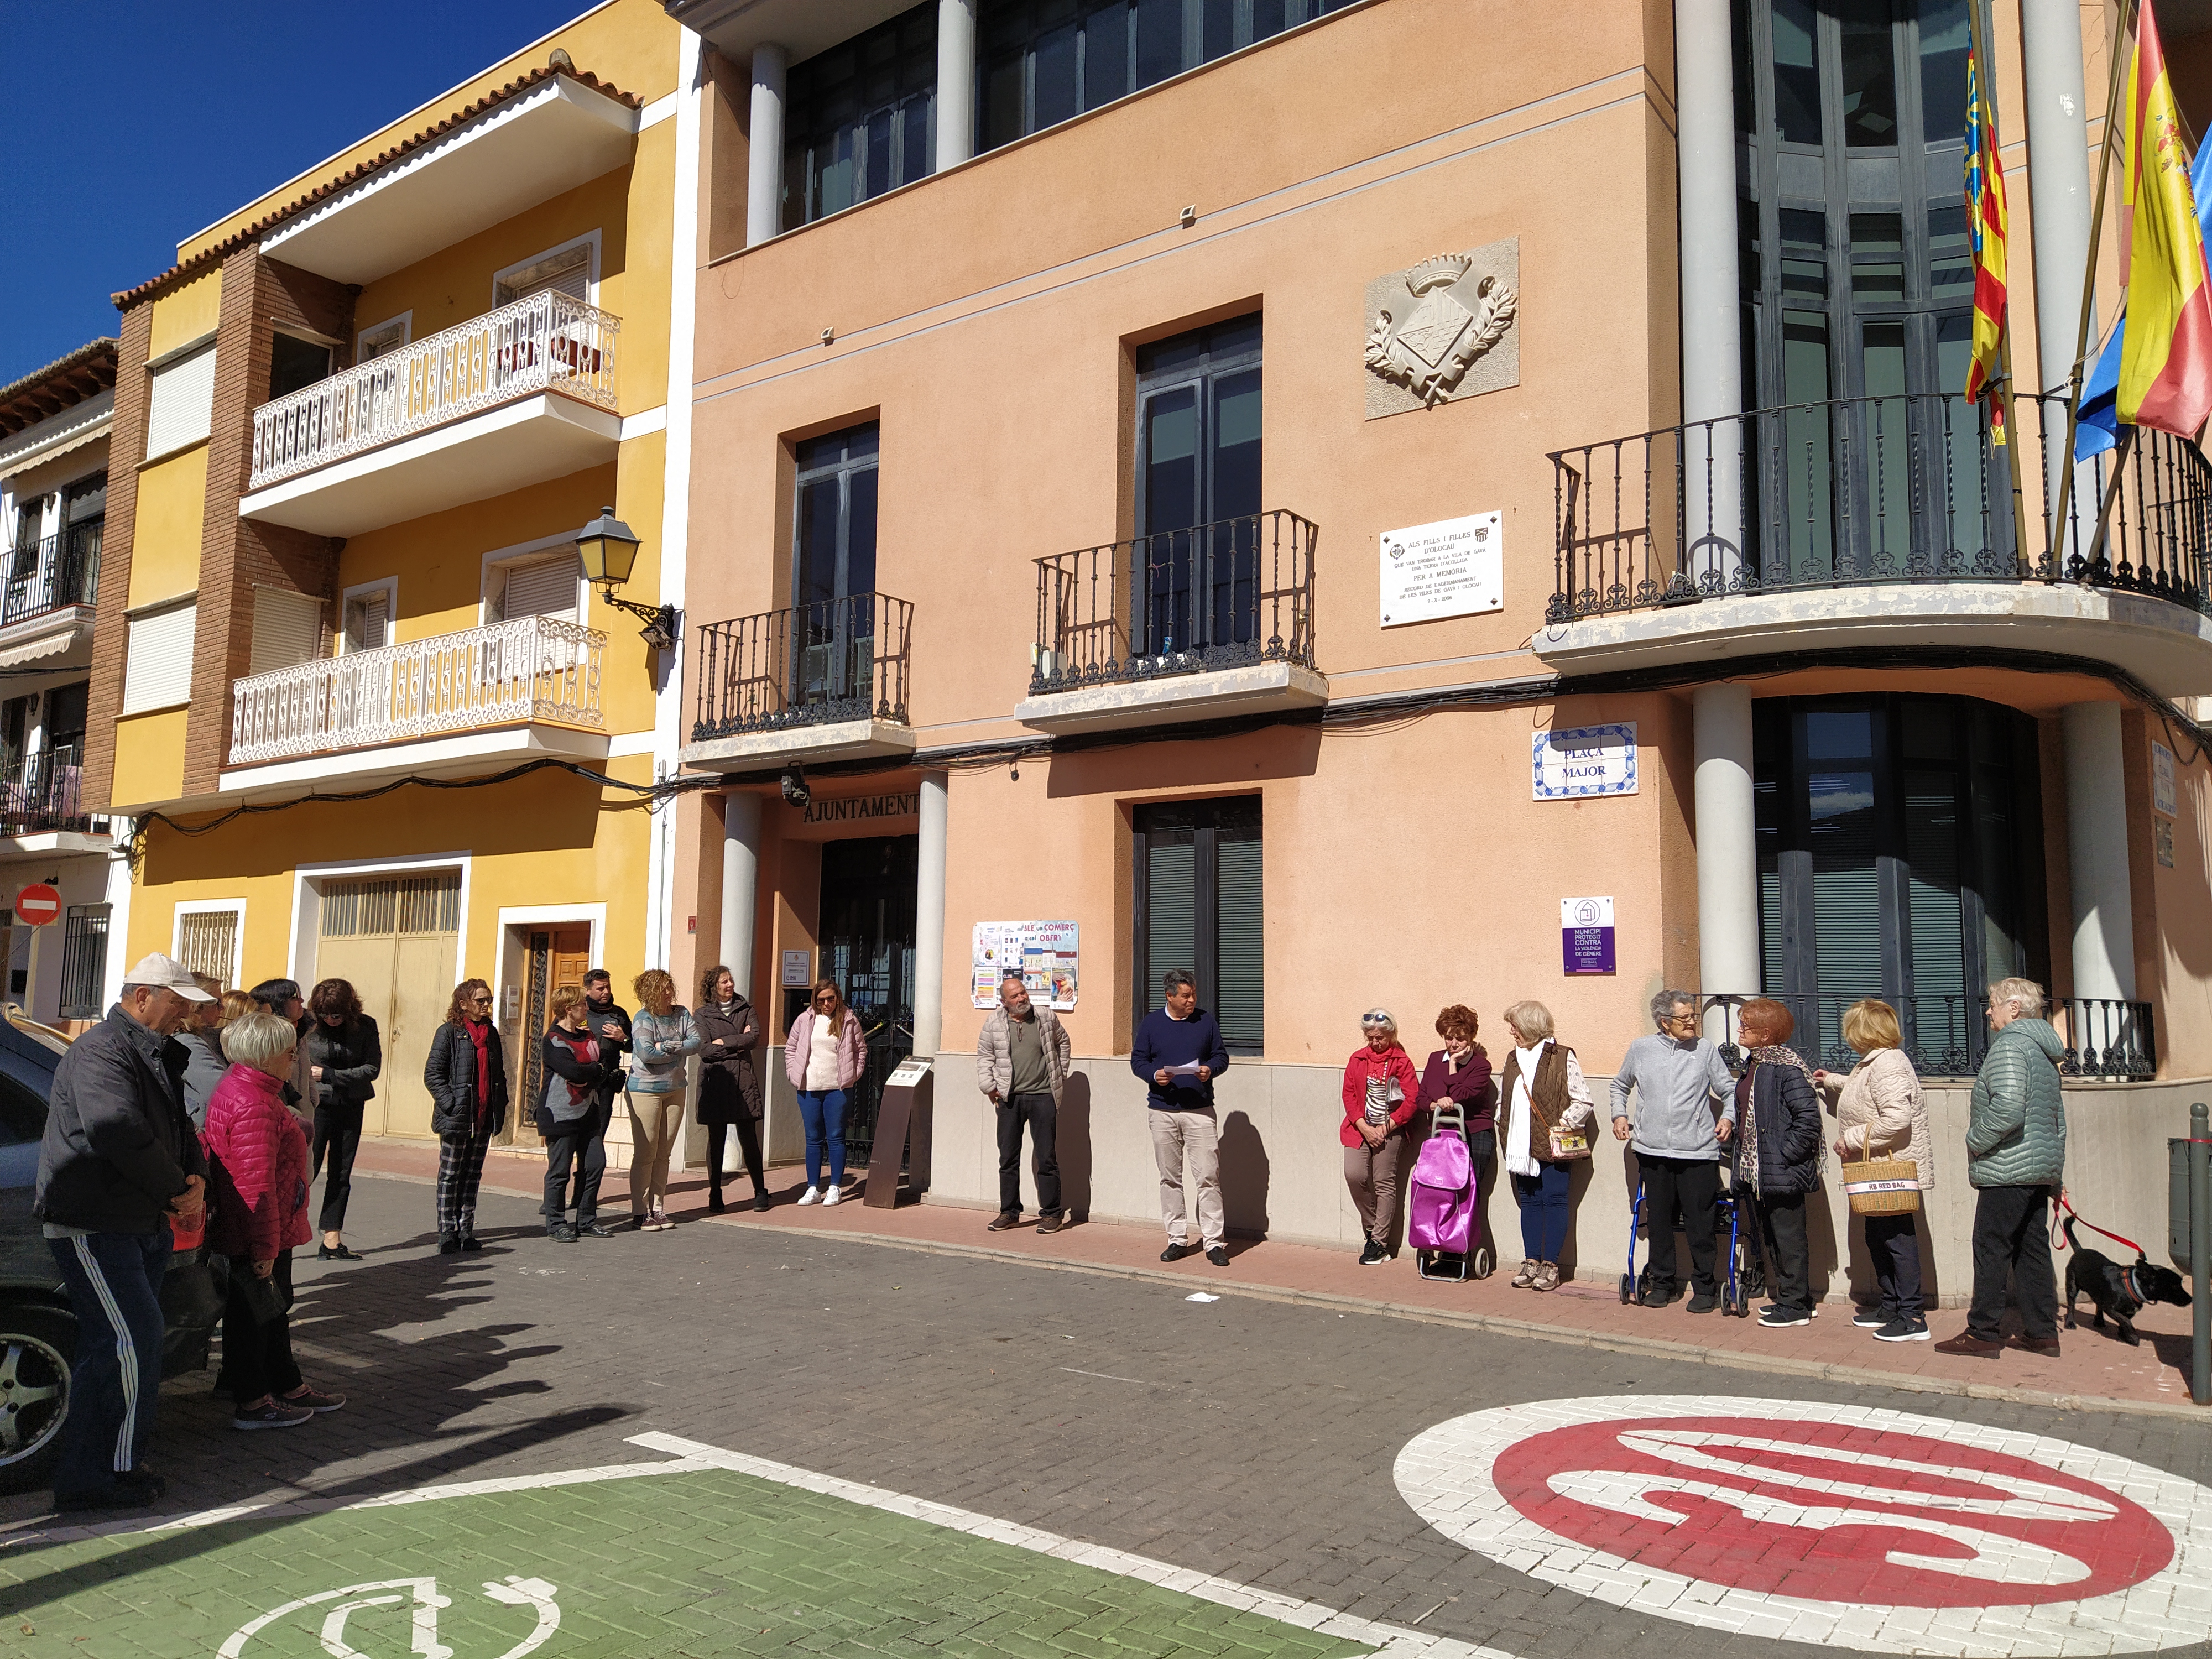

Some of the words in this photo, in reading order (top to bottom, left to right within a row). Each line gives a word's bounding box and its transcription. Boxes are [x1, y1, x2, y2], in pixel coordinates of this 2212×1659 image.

[1423, 537, 1441, 545] FILLS
[1449, 531, 1471, 541] FILLES
[1424, 542, 1455, 554] D'OLOCAU
[1441, 557, 1468, 566] D'ACOLLIDA
[1436, 567, 1467, 577] MEMÒRIA
[1564, 747, 1604, 759] PLAÇA
[1562, 765, 1607, 778] MAJOR
[803, 794, 920, 823] AJUNTAMENT
[1044, 924, 1074, 932] COMERÇ
